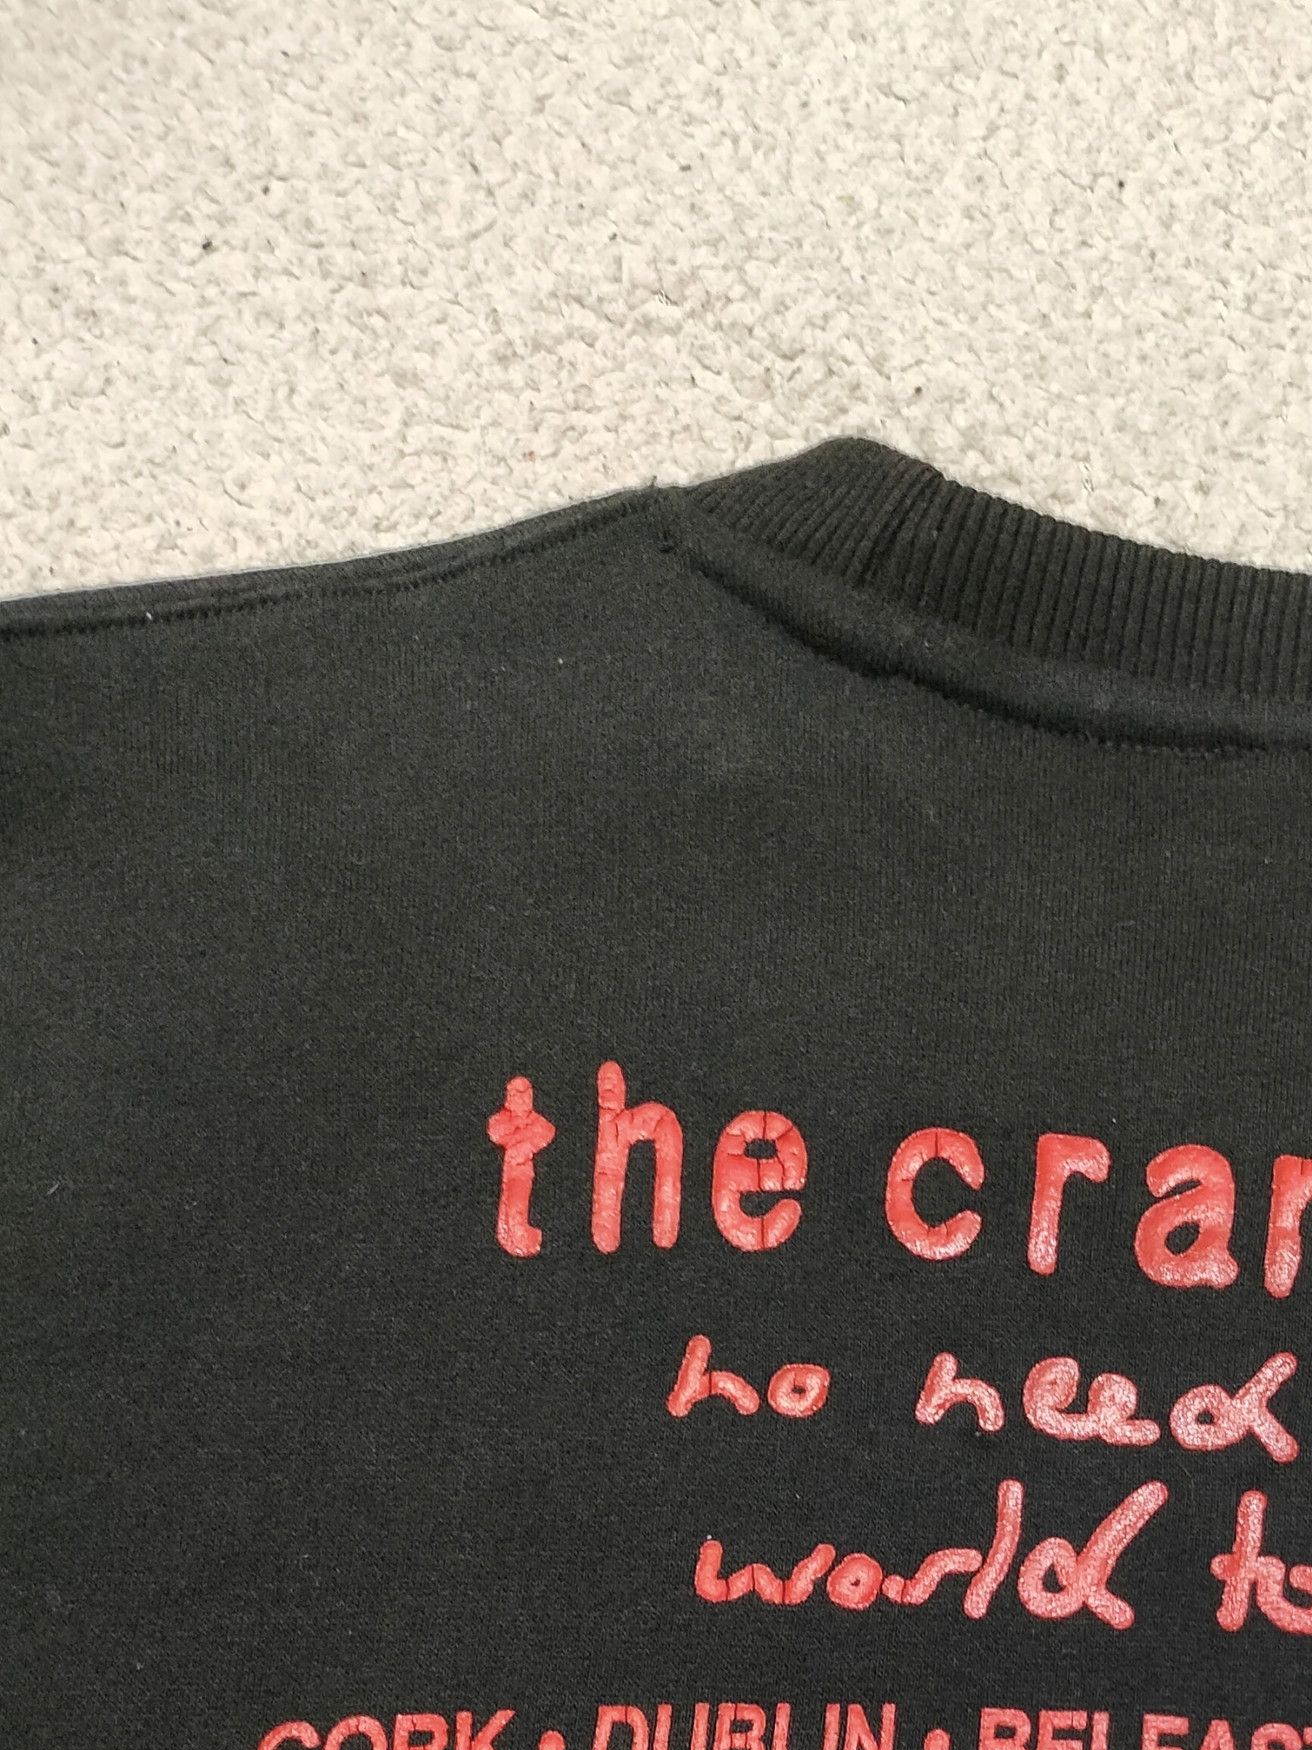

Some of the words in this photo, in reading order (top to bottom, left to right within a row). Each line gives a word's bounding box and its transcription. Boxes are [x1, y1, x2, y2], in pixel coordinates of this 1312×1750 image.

[484, 1058, 811, 1260] the
[664, 1333, 833, 1420] no
[913, 1349, 1302, 1466] need
[692, 1476, 1171, 1633] world
